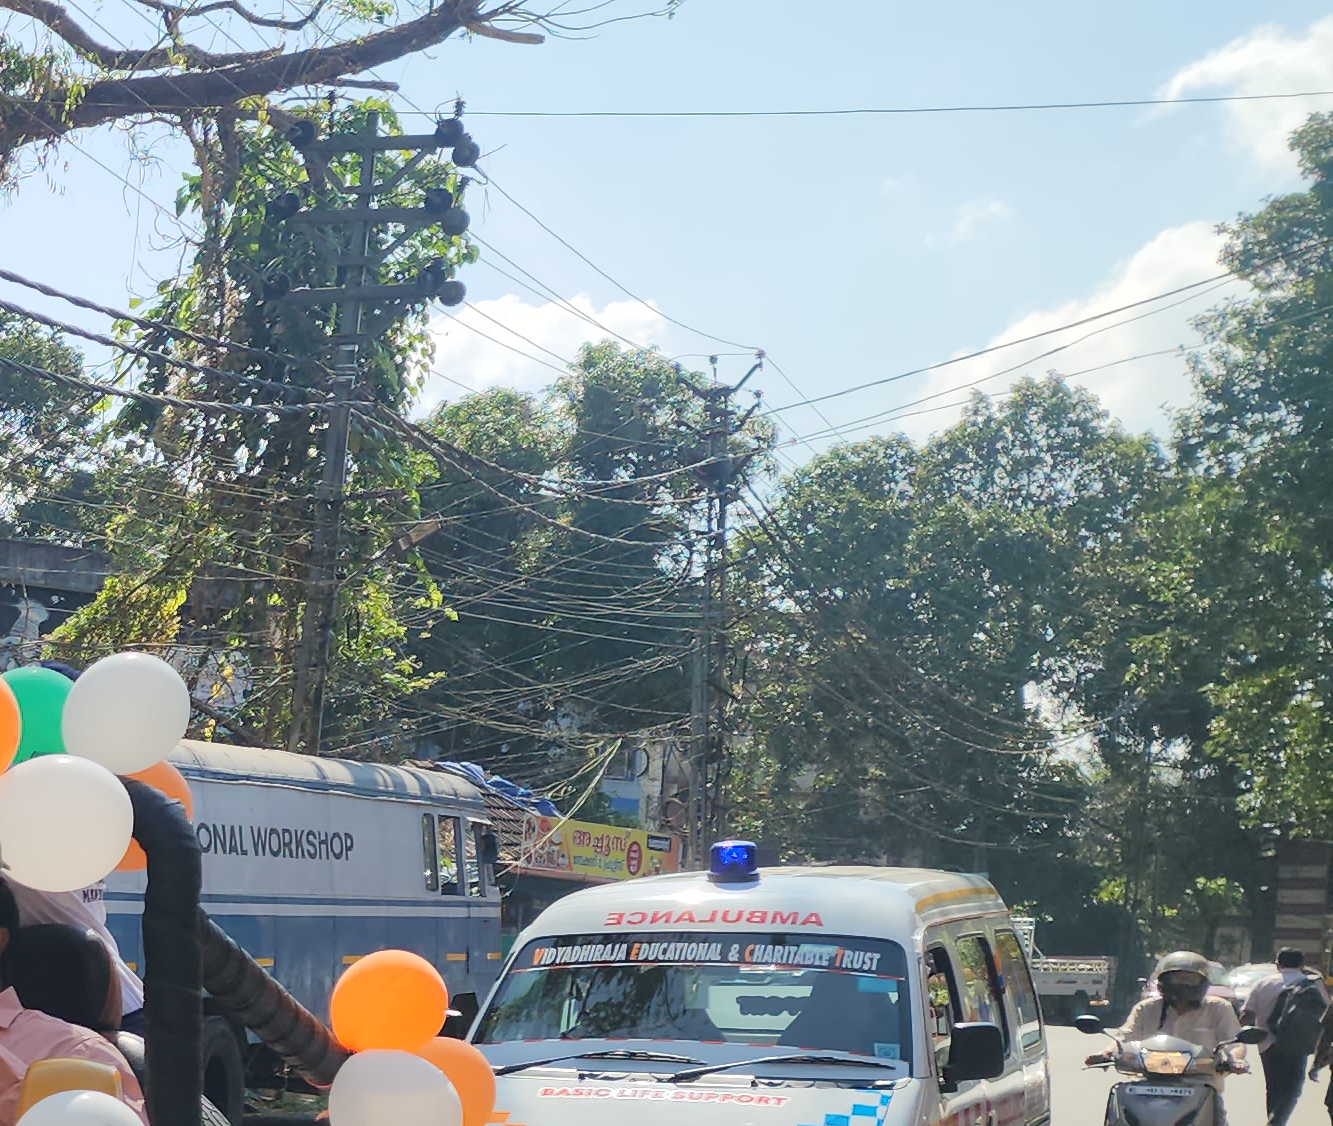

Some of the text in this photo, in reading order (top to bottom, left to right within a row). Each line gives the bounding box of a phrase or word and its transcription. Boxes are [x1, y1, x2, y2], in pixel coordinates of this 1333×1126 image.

[196, 822, 354, 861] ONAL WORKSHOP
[533, 942, 881, 971] VIDYADHIRAJA EDUCATIONAL & CHARITABLE TRUST
[539, 1087, 788, 1106] BASIC LIFE SUPPORT
